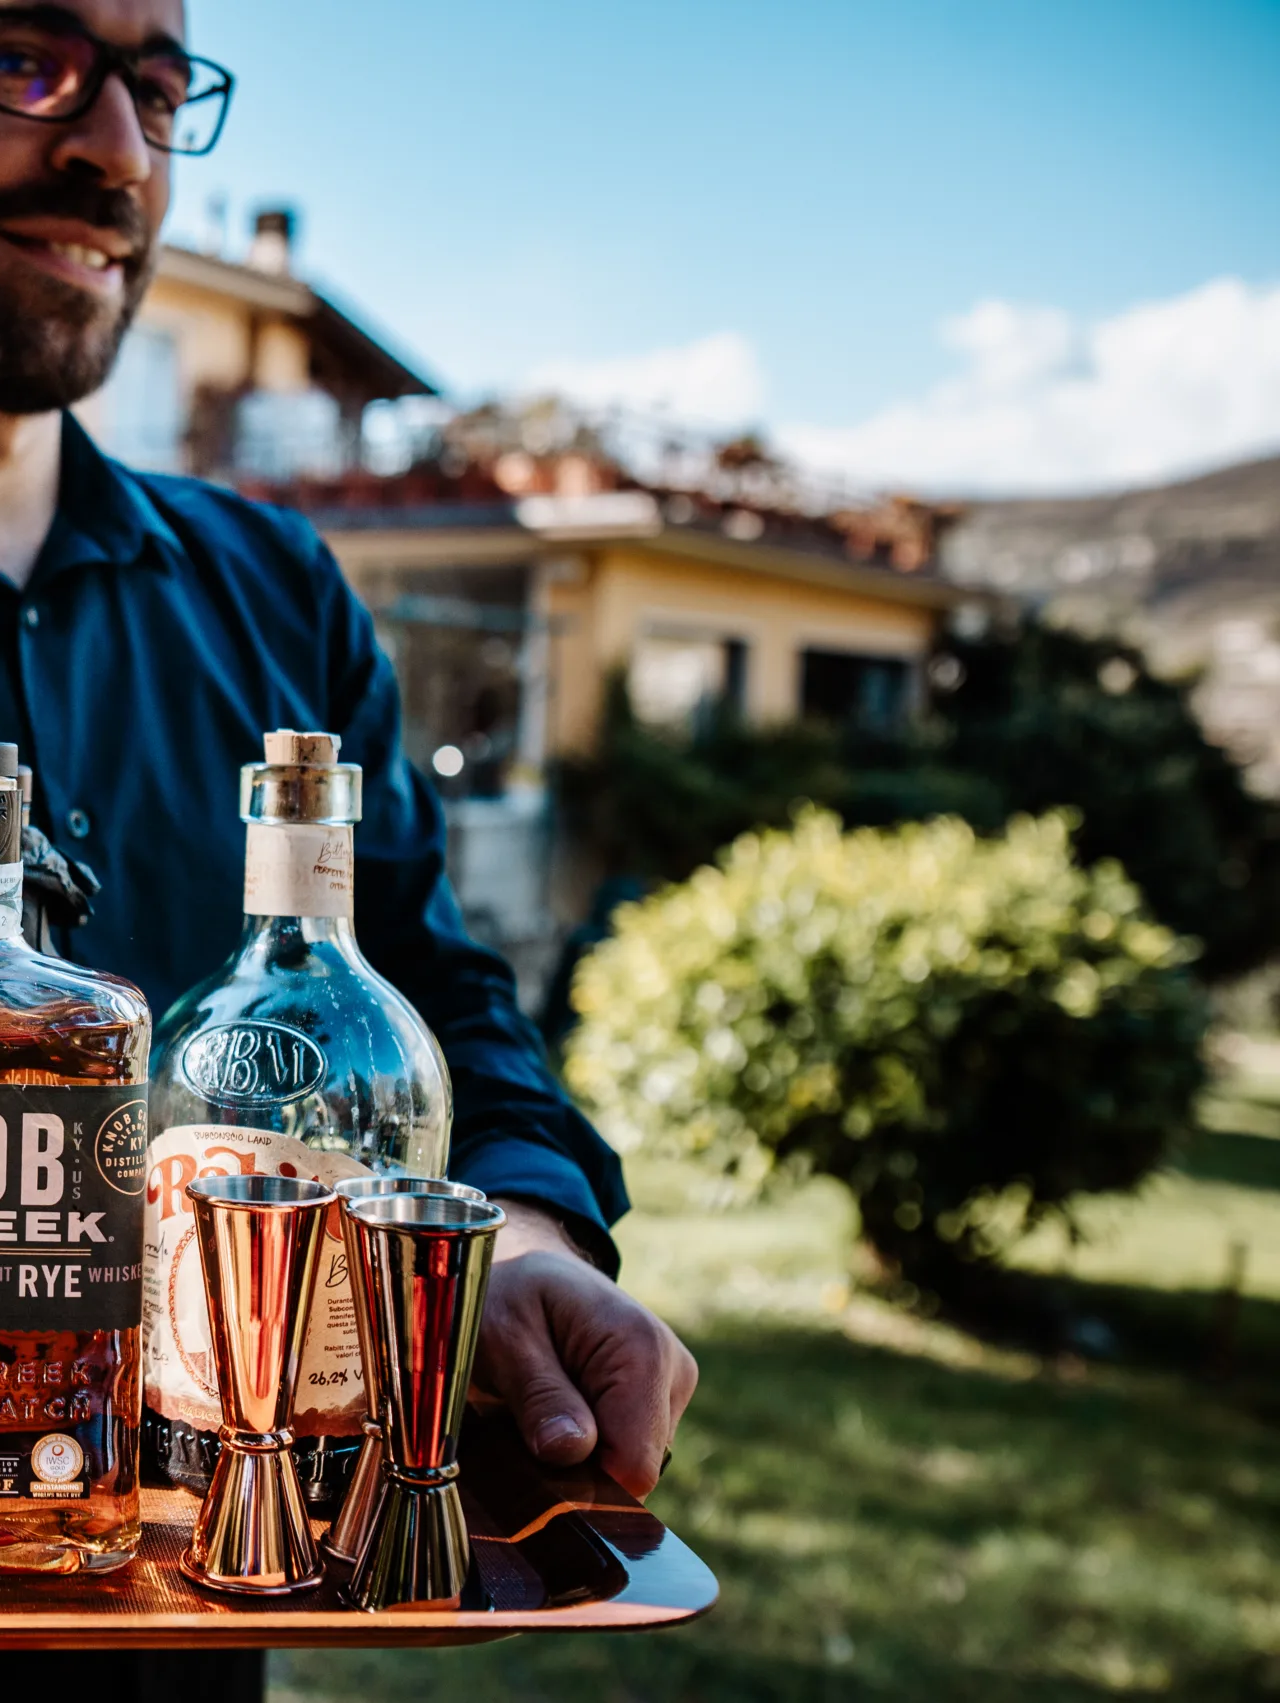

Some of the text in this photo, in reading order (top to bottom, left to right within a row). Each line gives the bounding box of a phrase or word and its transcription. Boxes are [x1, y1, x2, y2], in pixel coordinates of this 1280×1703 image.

[102, 1113, 132, 1152] KNOB
[194, 1131, 272, 1146] SUBCONSCIO LAND
[130, 1135, 143, 1151] KY
[18, 1263, 82, 1298] RYE
[308, 1368, 349, 1386] 26,2%
[46, 1456, 70, 1465] IWSC
